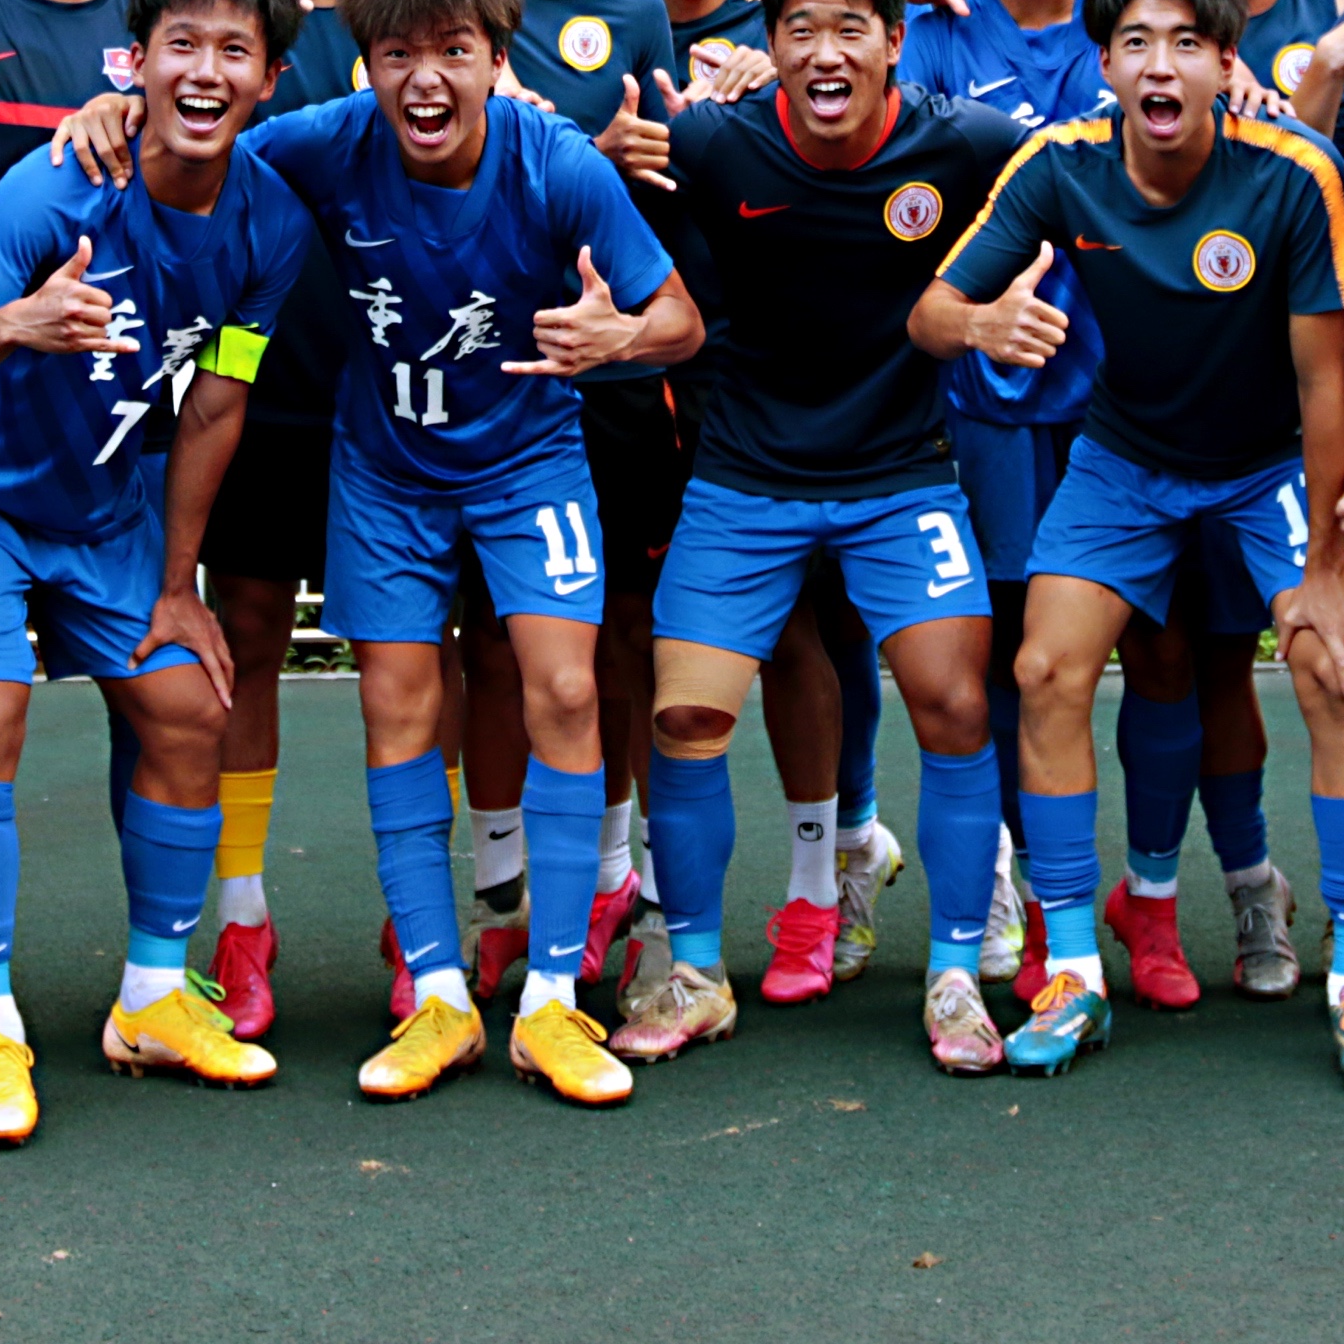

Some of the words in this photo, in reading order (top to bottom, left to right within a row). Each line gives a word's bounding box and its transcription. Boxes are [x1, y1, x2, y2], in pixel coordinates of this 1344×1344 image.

[391, 362, 449, 427] 11
[92, 400, 152, 466] 7
[536, 501, 598, 577] 11
[917, 510, 971, 579] 3
